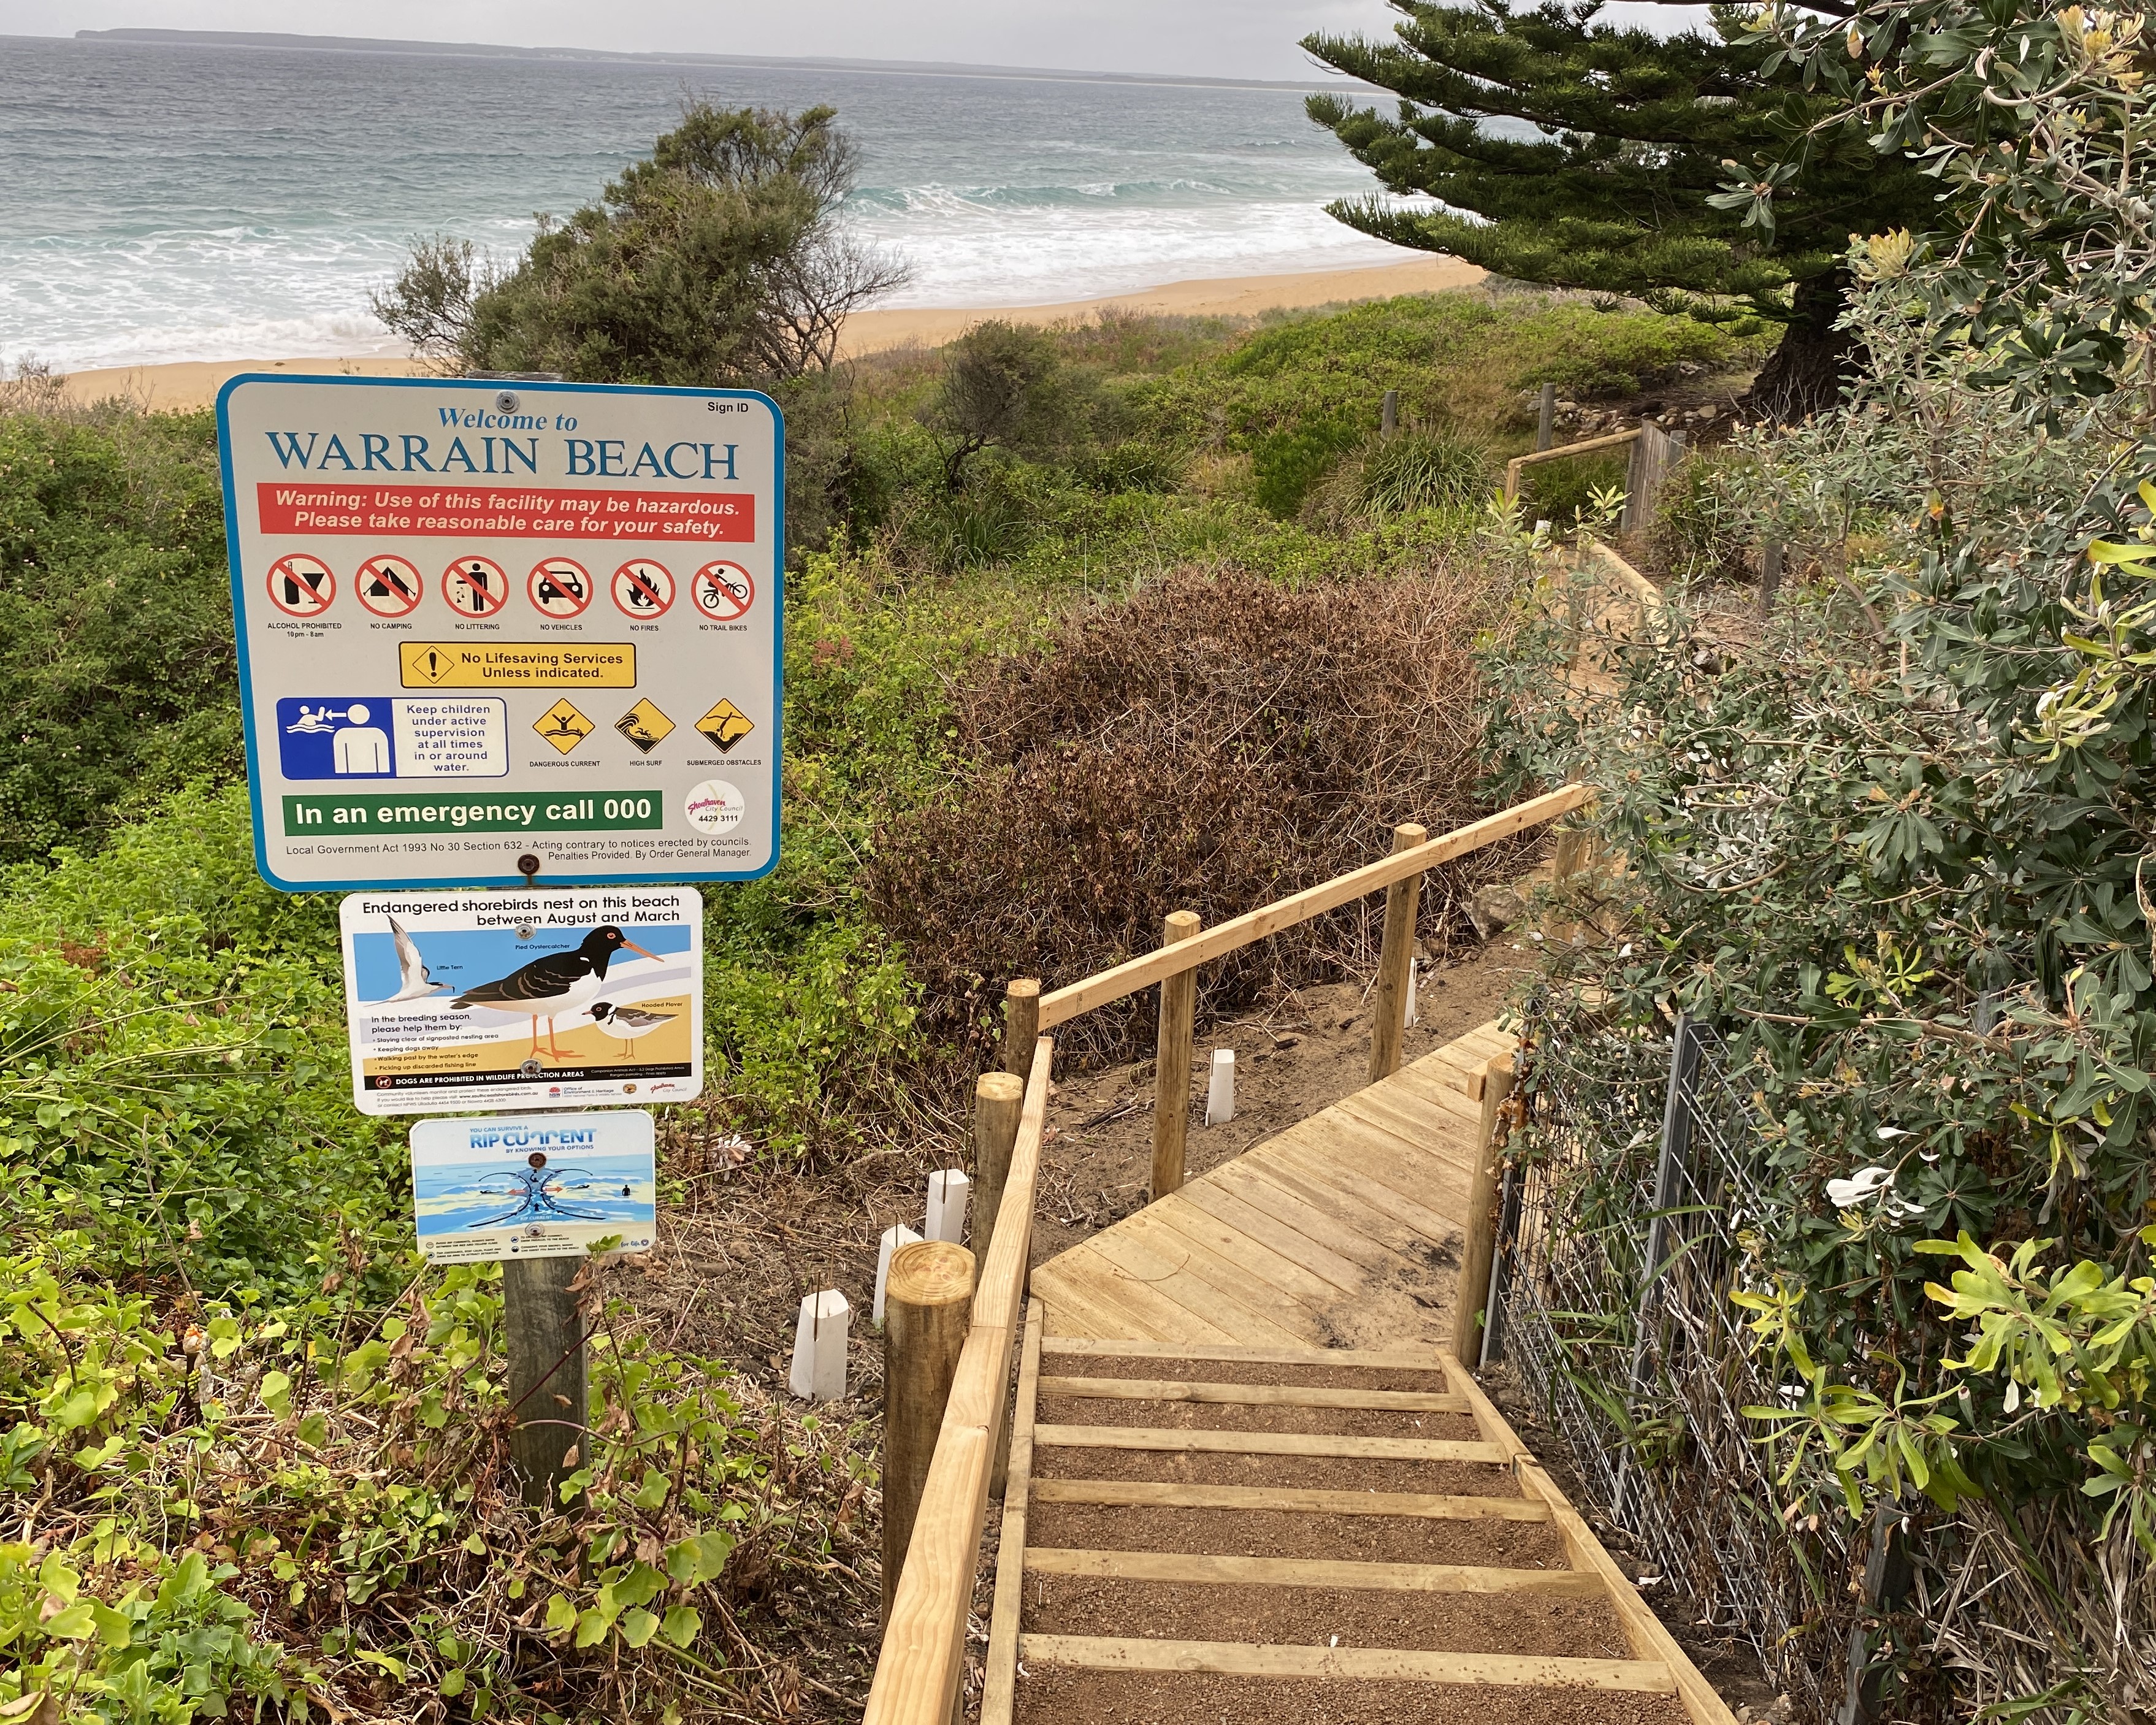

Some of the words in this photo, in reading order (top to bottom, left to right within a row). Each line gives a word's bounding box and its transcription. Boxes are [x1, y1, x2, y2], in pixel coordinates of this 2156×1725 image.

[708, 402, 733, 413] Sign
[737, 403, 749, 412] ID
[438, 407, 547, 430] Welcome
[556, 413, 578, 430] to
[265, 432, 539, 474] WARRAIN
[564, 439, 739, 480] BEACH
[276, 490, 367, 510] Warning:
[375, 492, 413, 508] Use
[419, 492, 440, 508] of
[445, 494, 481, 509] this
[489, 494, 554, 514] facility
[560, 499, 601, 514] may
[606, 497, 629, 512] be
[635, 498, 739, 515] hazardous.
[295, 511, 362, 527] Please
[369, 513, 410, 528] take
[417, 514, 526, 530] reasonable
[532, 518, 575, 531] care
[581, 516, 608, 532] for
[613, 521, 657, 535] your
[662, 519, 724, 538] safety.
[461, 652, 480, 664] No
[486, 652, 559, 666] Lifesaving
[563, 653, 623, 664] Services
[482, 667, 530, 678] Unless
[535, 667, 604, 678] indicated.
[407, 705, 437, 715] Keep
[412, 716, 447, 725] under
[451, 716, 486, 725] active
[415, 728, 485, 738] supervision
[451, 740, 483, 748] times
[446, 751, 487, 760] around
[296, 803, 323, 824] In
[332, 807, 367, 824] an
[377, 804, 537, 826] emergency
[546, 799, 594, 820] call
[604, 798, 651, 819] 000
[687, 798, 726, 815] Shoalhaven
[286, 845, 314, 855] Local
[317, 844, 380, 854] Government
[383, 844, 399, 852] Act
[403, 843, 427, 852] 1993
[430, 843, 445, 851] No
[448, 842, 460, 851] 30
[464, 841, 500, 851] Section
[503, 841, 522, 850] 632
[532, 841, 562, 851] Acting
[565, 840, 605, 851] contrary
[608, 840, 617, 848] to
[621, 838, 655, 847] notices
[658, 838, 694, 847] erected
[697, 838, 708, 848] by
[711, 837, 752, 846] councils.
[548, 851, 589, 860] Penalties
[635, 850, 647, 860] By
[649, 849, 674, 858] Order
[677, 849, 710, 857] General
[713, 848, 751, 859] Manager.
[363, 900, 459, 915] Endangered
[462, 898, 538, 911] shorebirds
[544, 900, 573, 909] nest
[579, 899, 597, 908] on
[603, 897, 627, 908] this
[632, 895, 679, 907] beach
[477, 914, 541, 925] between
[547, 912, 597, 926] August
[601, 911, 629, 922] and
[634, 911, 679, 922] March
[470, 1134, 500, 1149] RIP
